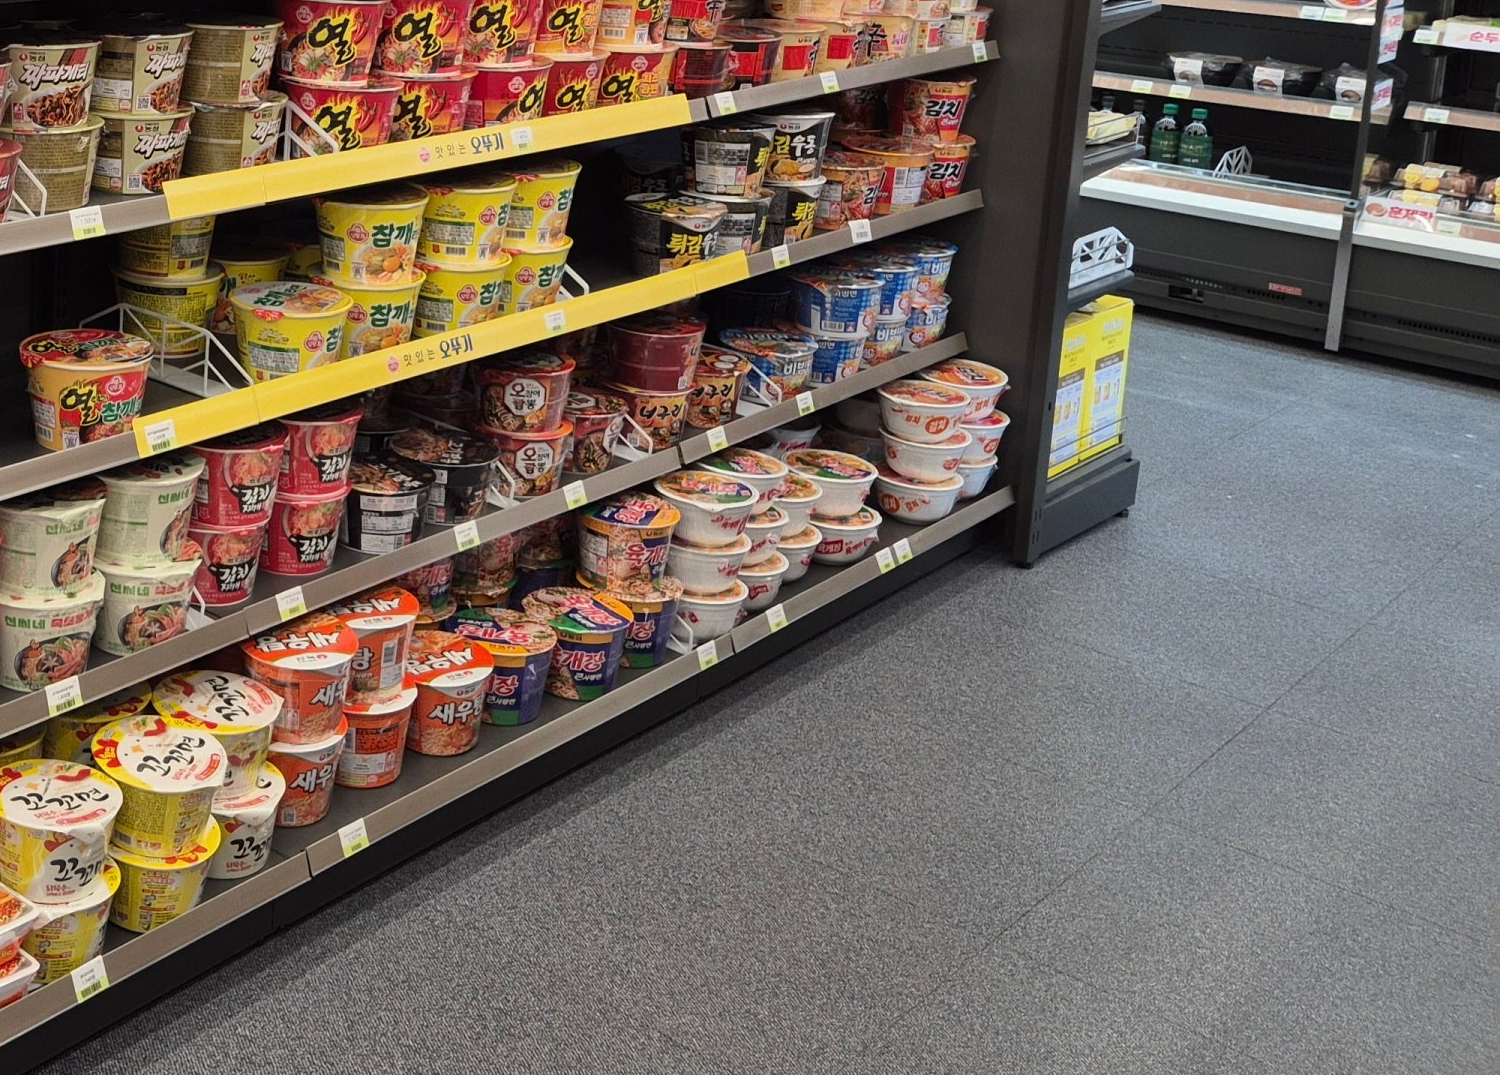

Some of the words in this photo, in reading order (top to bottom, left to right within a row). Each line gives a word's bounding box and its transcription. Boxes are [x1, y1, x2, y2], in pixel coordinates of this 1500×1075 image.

[396, 10, 441, 60] 열
[470, 2, 516, 50] 열
[308, 16, 357, 67] 열
[19, 62, 90, 90] 짜파게티
[925, 97, 960, 118] 김치
[472, 132, 504, 154] 오뚜기
[930, 162, 963, 181] 김치
[440, 333, 473, 358] 오뚜기
[640, 402, 685, 421] 너구리
[321, 454, 347, 473] 김치
[241, 484, 269, 504] 김치
[300, 535, 328, 552] 김치
[219, 564, 247, 581] 김치
[137, 736, 204, 777] 꼬꼬면
[10, 787, 109, 812] 꼬꼬면
